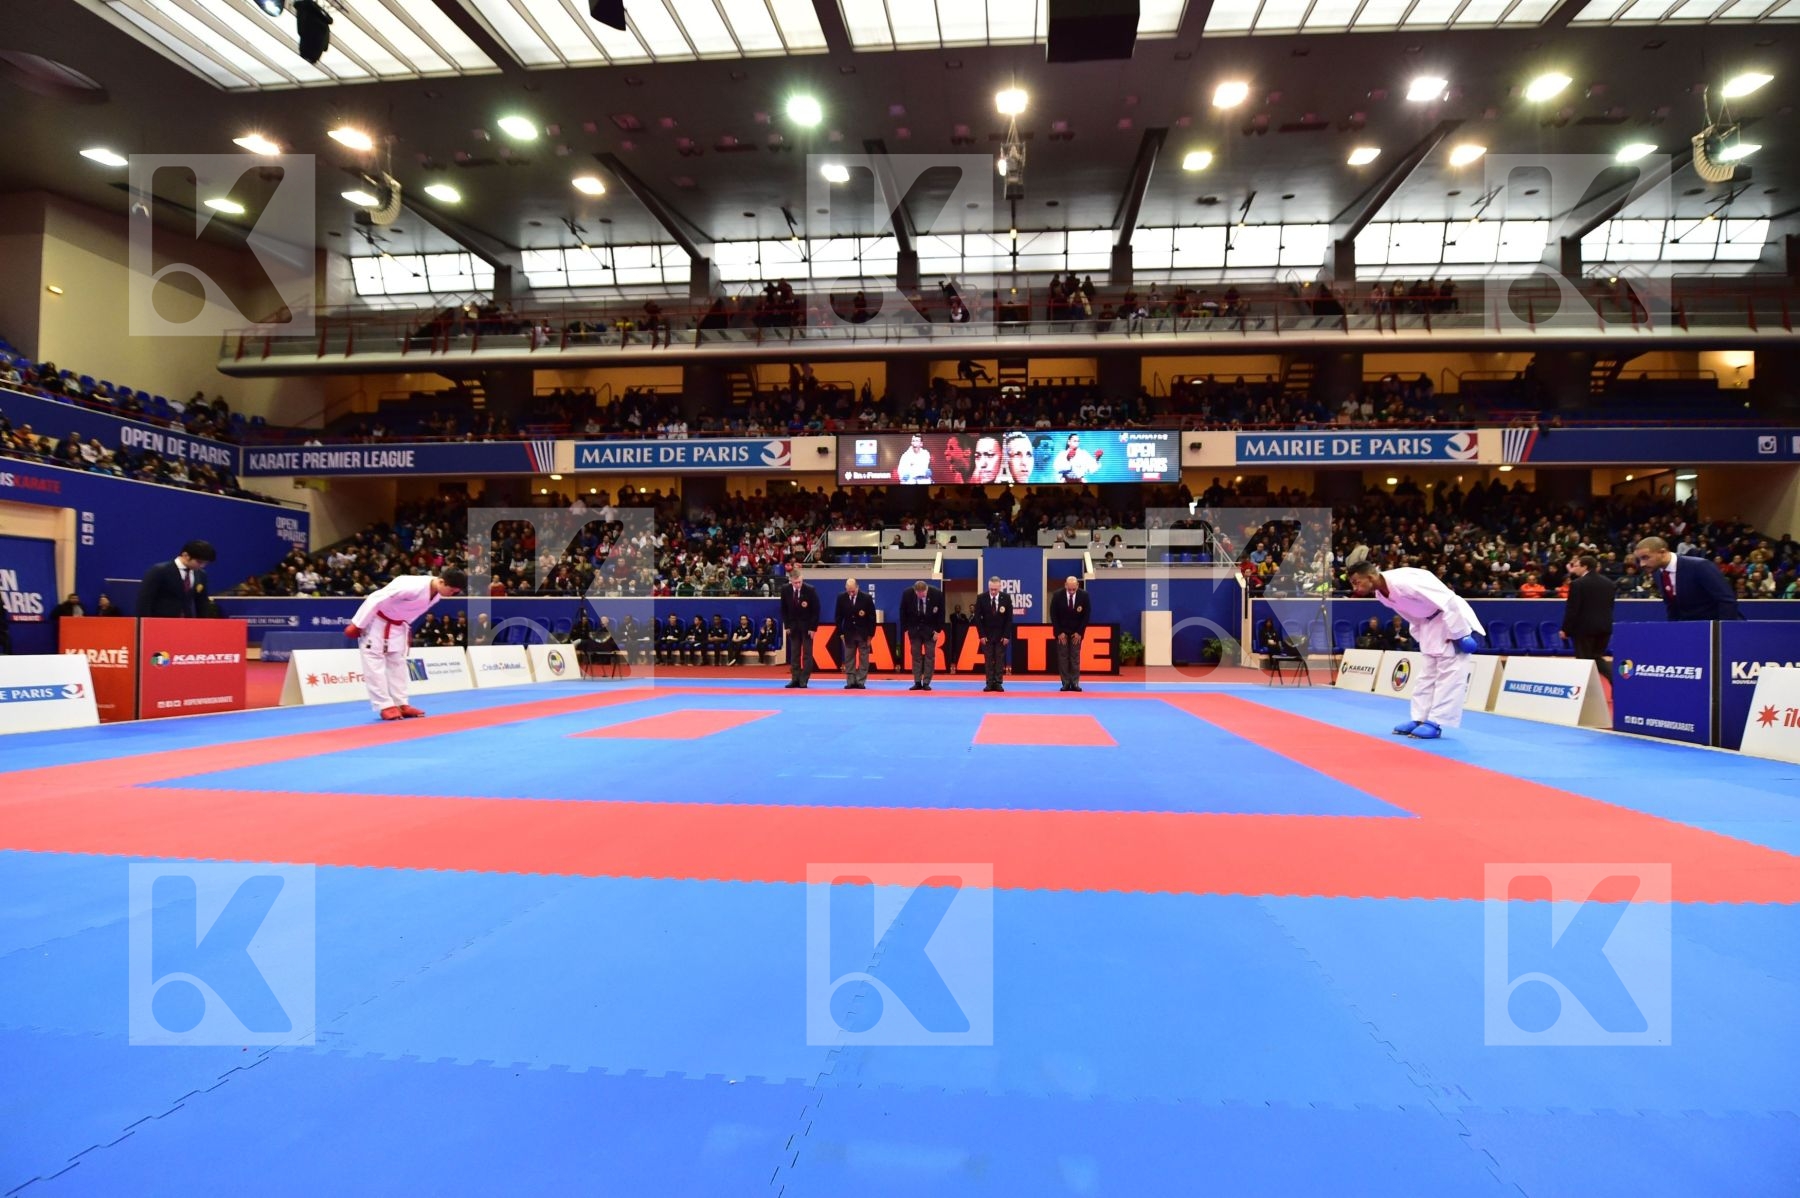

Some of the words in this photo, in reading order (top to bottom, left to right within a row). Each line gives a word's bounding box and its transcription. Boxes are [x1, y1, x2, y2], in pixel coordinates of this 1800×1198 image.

[121, 426, 164, 452] OPEN
[167, 436, 187, 457] DE
[190, 442, 231, 466] PARIS
[582, 448, 652, 463] MAIRIE
[659, 447, 685, 462] DE
[693, 446, 749, 461] PARIS
[1245, 440, 1325, 456] MAIRIE
[1332, 439, 1361, 455] DE
[1369, 438, 1432, 455] PARIS
[250, 453, 299, 469] KARATE
[303, 452, 361, 468] PREMIER
[364, 450, 415, 467] LEAGUE
[1000, 580, 1020, 593] PEN
[11, 688, 54, 700] PARIS
[1509, 682, 1531, 693] MAIRIE
[1532, 684, 1543, 694] DE
[1543, 686, 1565, 697] PARIS
